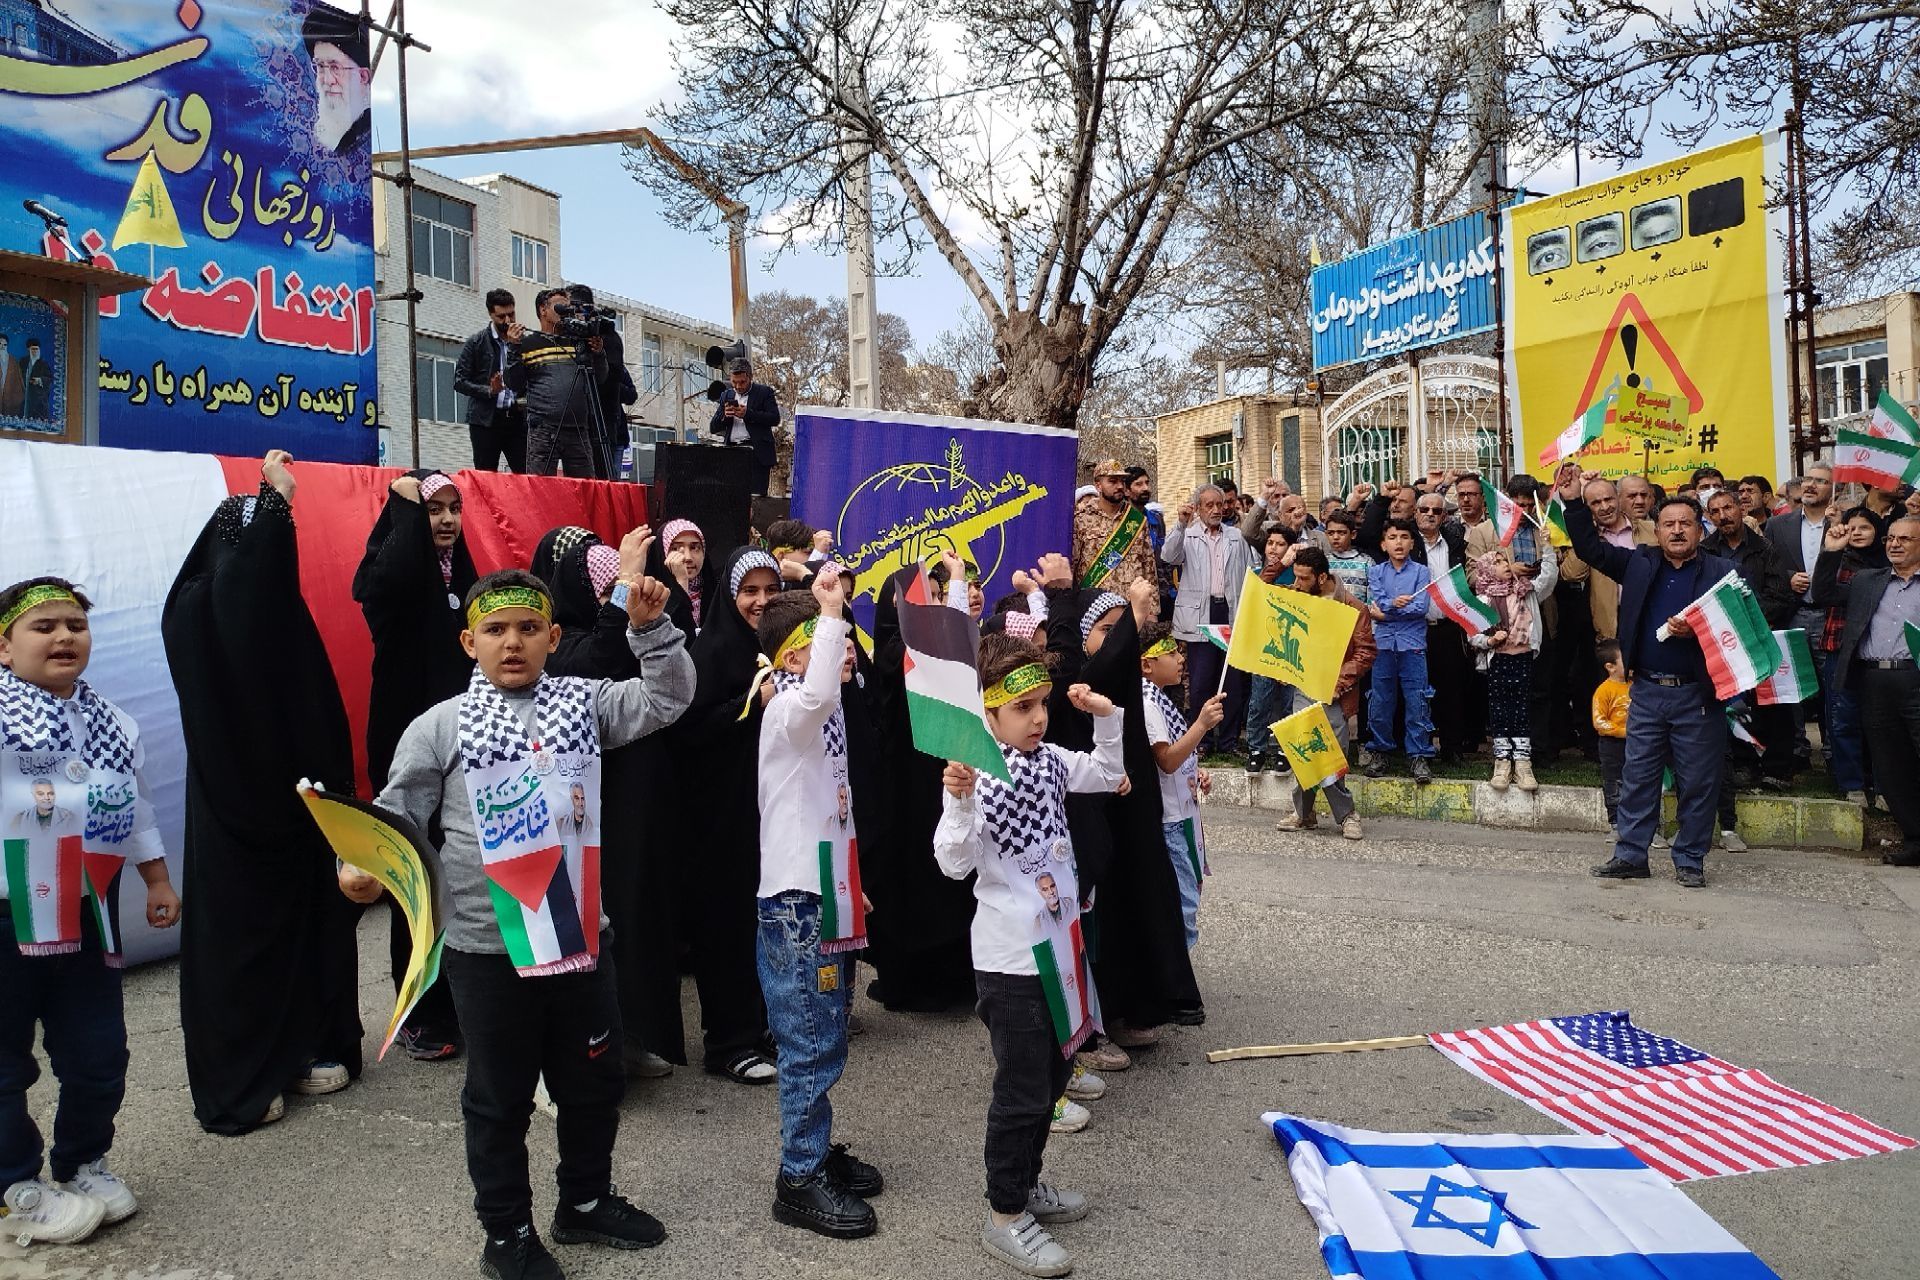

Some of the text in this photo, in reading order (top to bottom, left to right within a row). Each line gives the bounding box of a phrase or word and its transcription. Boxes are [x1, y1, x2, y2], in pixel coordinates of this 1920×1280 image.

[1656, 162, 1690, 185] خودرو
[203, 150, 335, 250] روز جهانی
[1597, 184, 1625, 202] خواب
[1467, 236, 1504, 286] بکه
[1381, 259, 1466, 305] بهداشت
[1637, 272, 1659, 285] خواب
[1662, 266, 1688, 282] هنگام
[1361, 300, 1460, 357] شهرستان بیجار
[99, 360, 377, 427] و آینده آن همراه با رست
[1636, 392, 1670, 413] بسیج
[1619, 410, 1652, 430] پزشکی
[1655, 418, 1685, 437] جامعه
[1661, 462, 1680, 475] ملی
